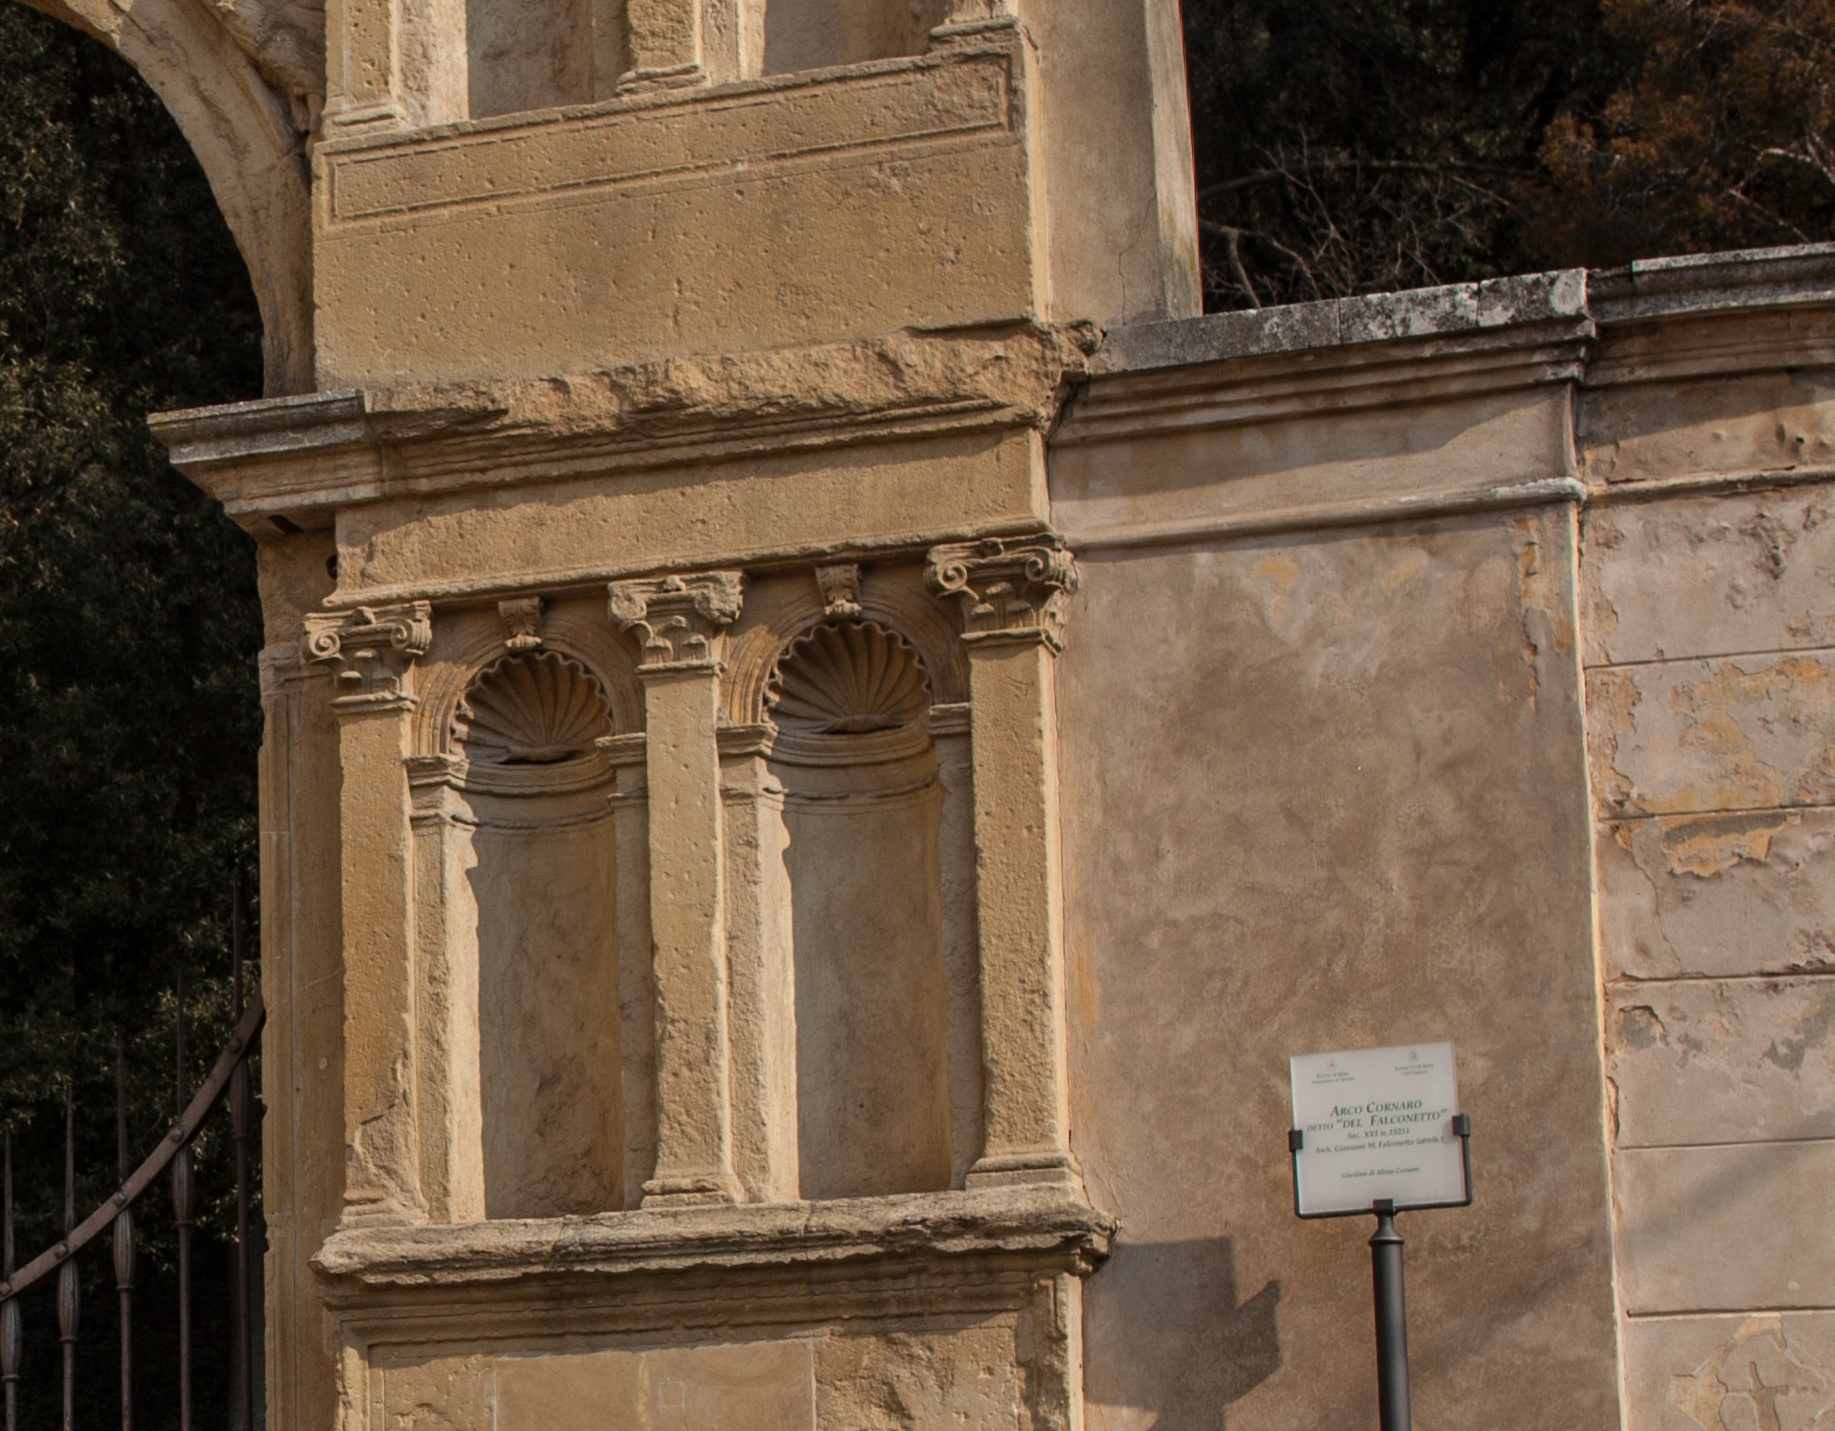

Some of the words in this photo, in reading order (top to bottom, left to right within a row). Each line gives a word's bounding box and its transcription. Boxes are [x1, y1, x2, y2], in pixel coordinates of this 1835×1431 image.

[1331, 1105, 1363, 1117] ARCO
[1366, 1100, 1423, 1113] CORNARO
[1307, 1123, 1334, 1132] DETTO
